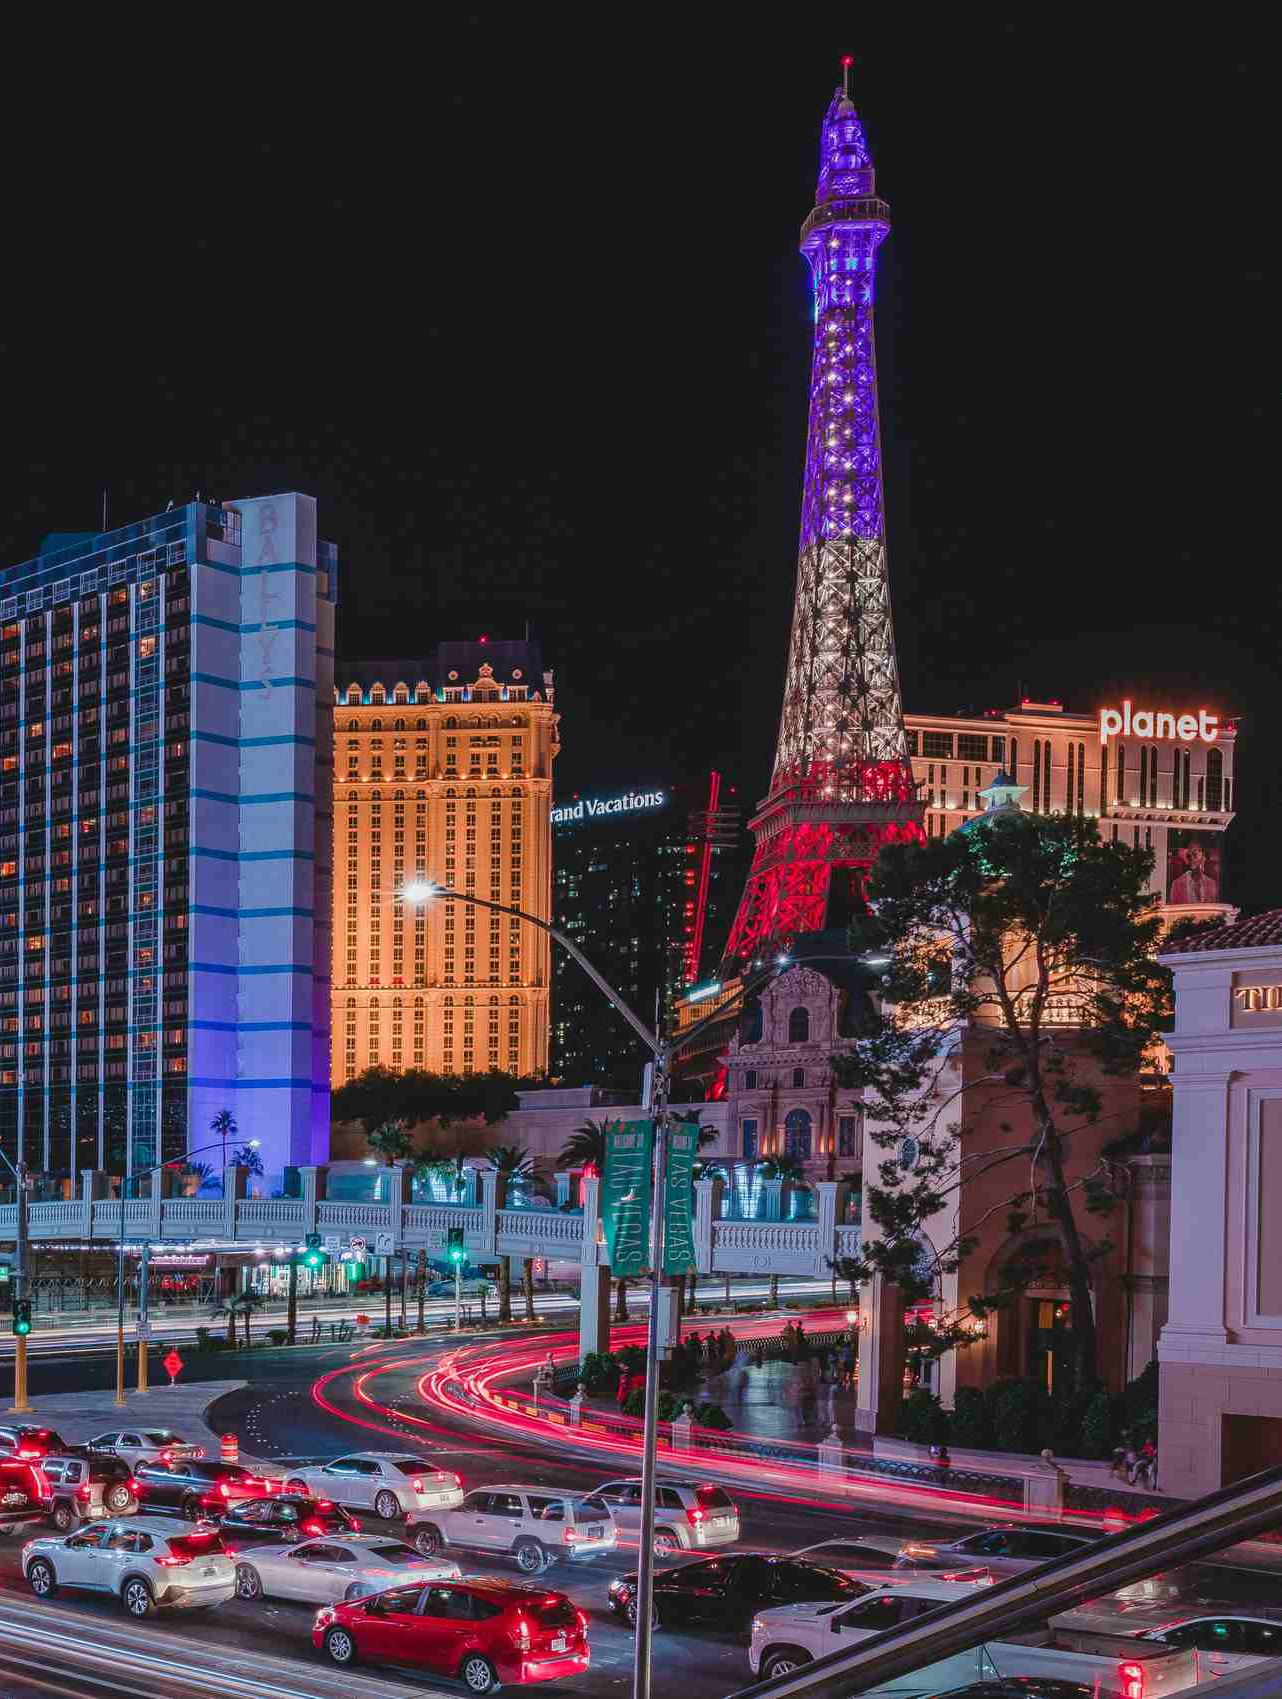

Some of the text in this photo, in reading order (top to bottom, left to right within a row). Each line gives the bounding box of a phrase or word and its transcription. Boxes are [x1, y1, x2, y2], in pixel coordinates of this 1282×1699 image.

[1100, 700, 1218, 744] planet
[550, 791, 664, 823] rand Vacations
[670, 1152, 691, 1189] LAS
[668, 1197, 691, 1261] VEGAS
